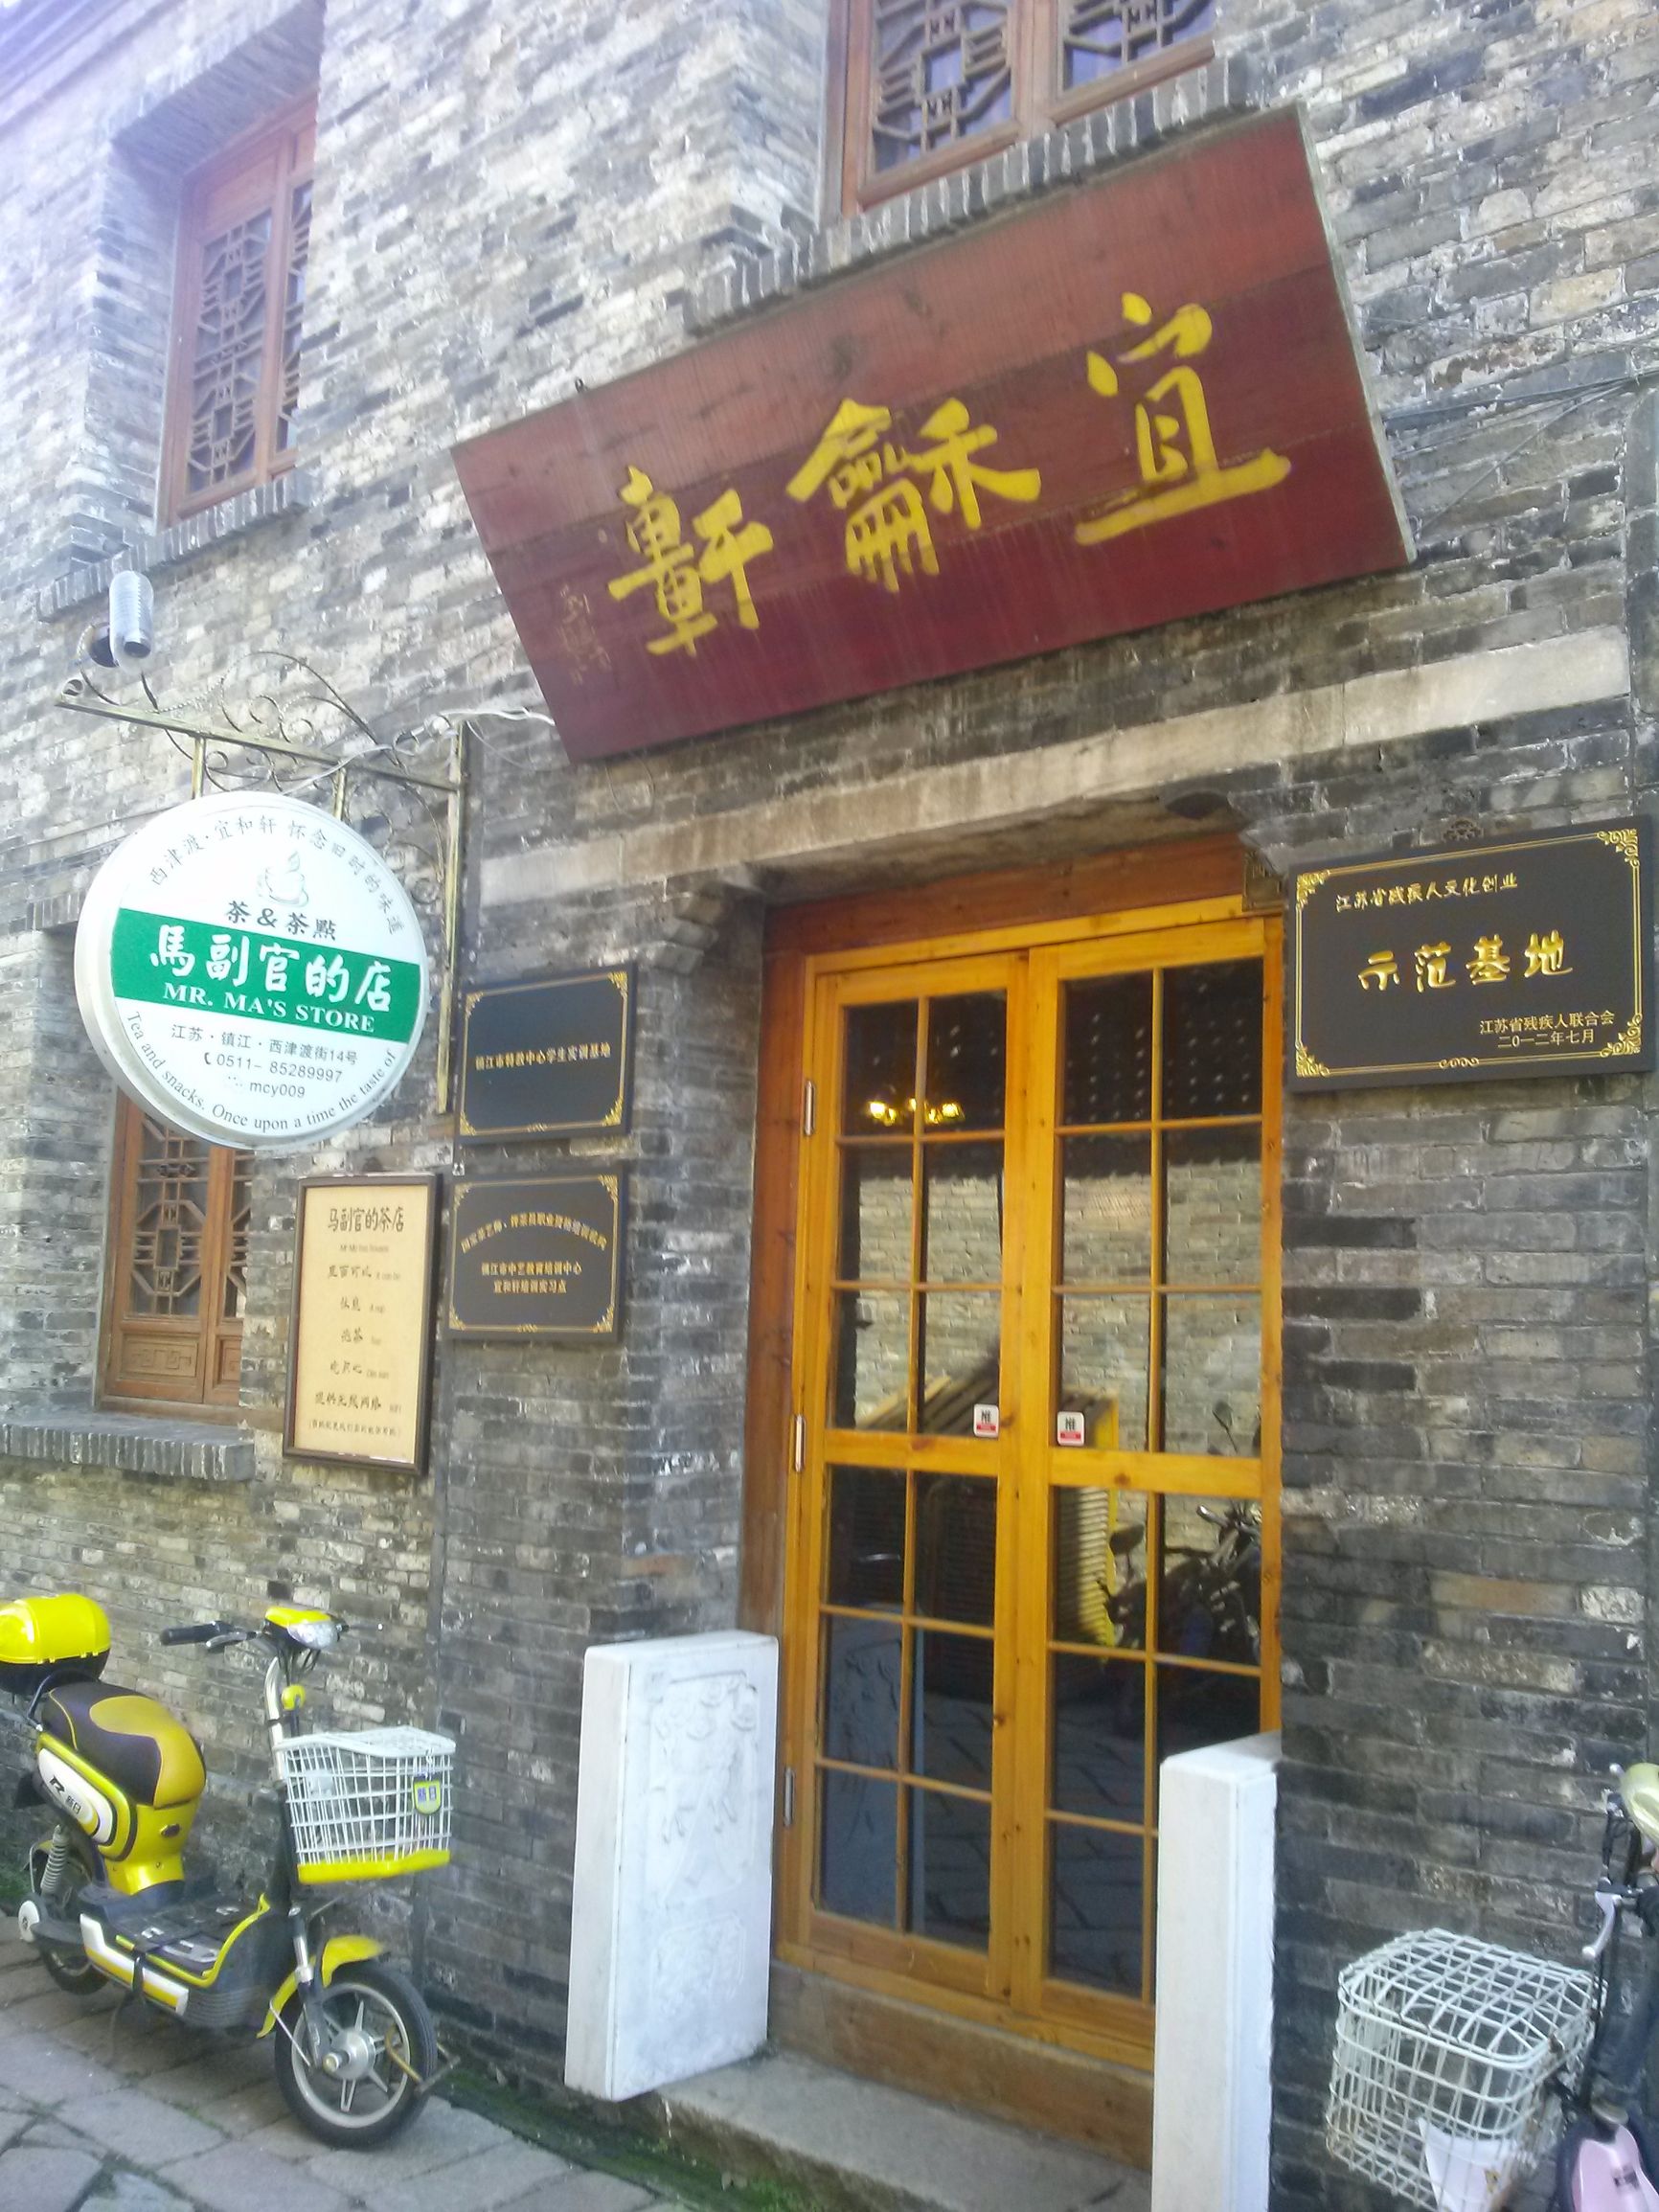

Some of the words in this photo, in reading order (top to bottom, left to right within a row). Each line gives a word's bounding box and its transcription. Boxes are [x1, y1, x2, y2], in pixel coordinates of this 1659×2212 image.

[1335, 872, 1518, 912] 江苏省残疾人文化创业
[149, 924, 391, 1013] 馬副官的店
[1357, 929, 1574, 992] 示范基地
[163, 982, 214, 1006] MR.
[224, 992, 286, 1017] MA'S
[295, 1004, 375, 1033] STORE
[1479, 1010, 1615, 1035] 江苏省残疾人联合会
[127, 1011, 144, 1039] Tea
[141, 1043, 166, 1069] and
[162, 1070, 205, 1110] snacks.
[212, 1104, 249, 1127] Once
[254, 1117, 288, 1132] upon
[294, 1117, 302, 1129] a
[307, 1108, 335, 1125] time
[338, 1093, 358, 1111] the
[359, 1067, 385, 1096] taste
[384, 1048, 397, 1067] of
[249, 1082, 306, 1099] mcy009
[328, 1206, 404, 1233] 马副官的茶店
